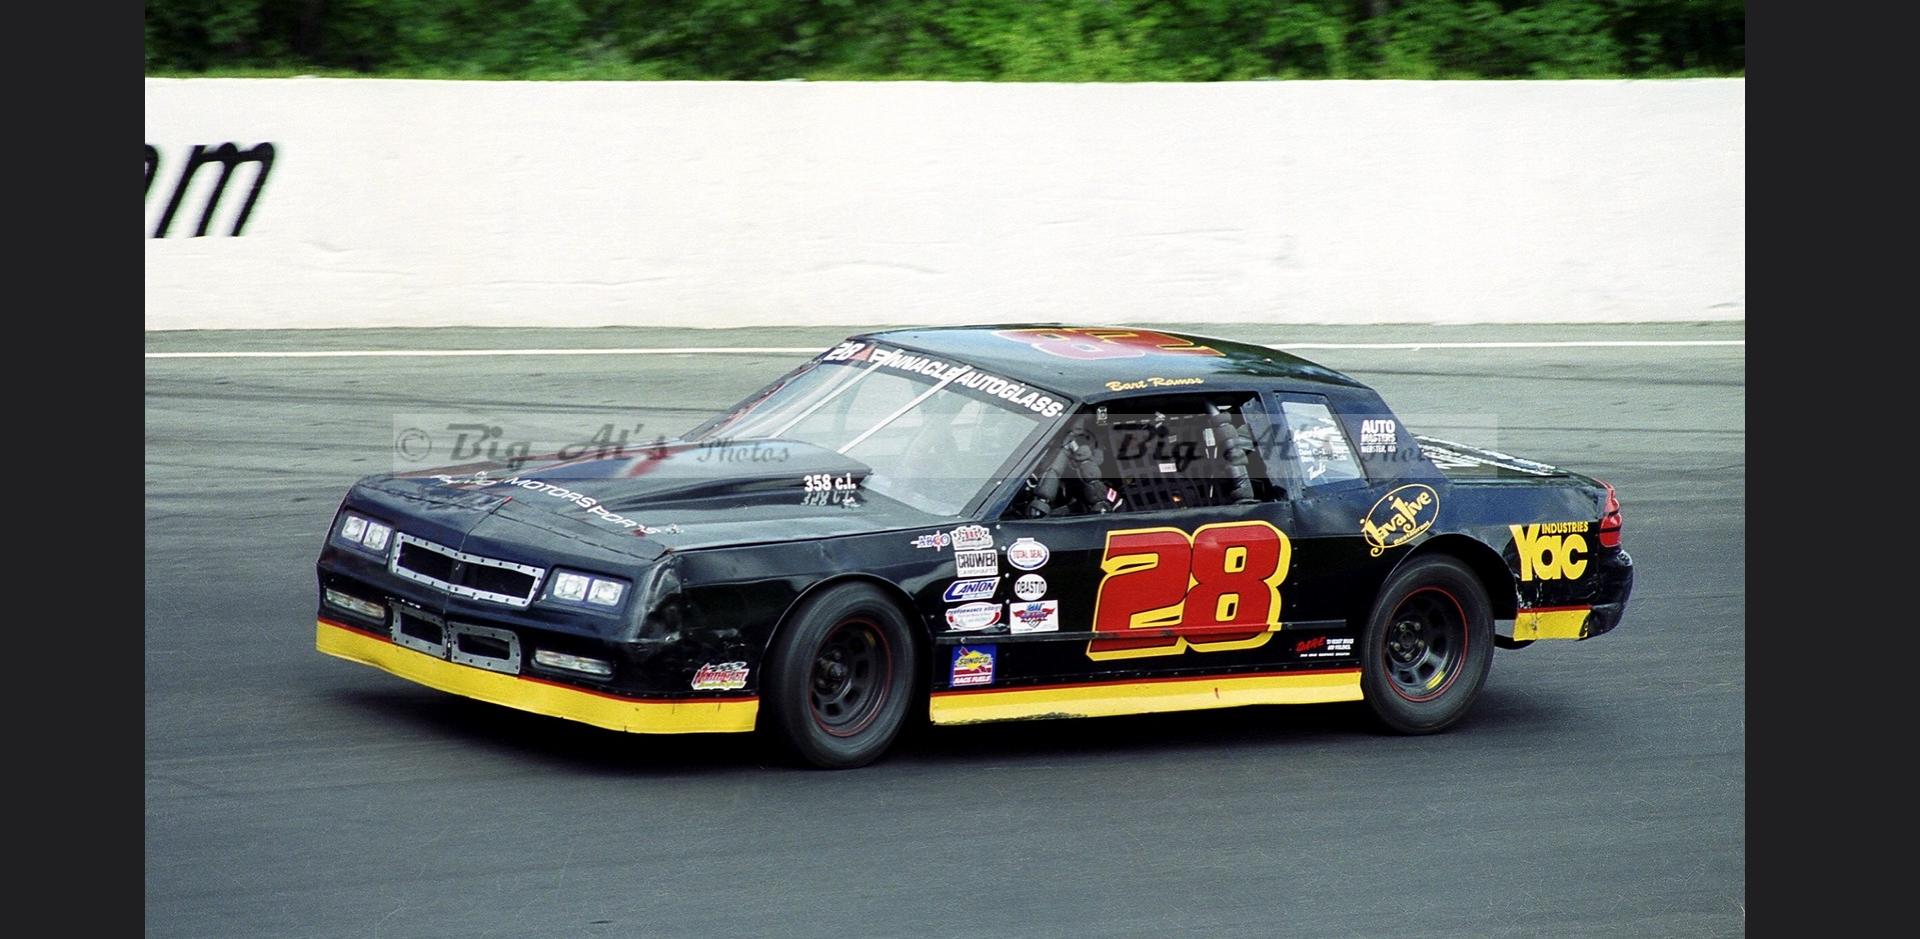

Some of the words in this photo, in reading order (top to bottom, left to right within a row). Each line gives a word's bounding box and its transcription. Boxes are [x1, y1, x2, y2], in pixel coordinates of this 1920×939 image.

[823, 341, 866, 361] 28
[1105, 380, 1148, 392] Bart
[1147, 377, 1204, 387] Ramos
[1361, 420, 1396, 434] AUTO
[803, 473, 832, 492] 358
[1541, 521, 1589, 534] INDUSTRIES
[957, 552, 997, 568] CROWER
[1509, 523, 1588, 582] Yac
[945, 578, 997, 600] CANTON
[1085, 520, 1292, 661] 28
